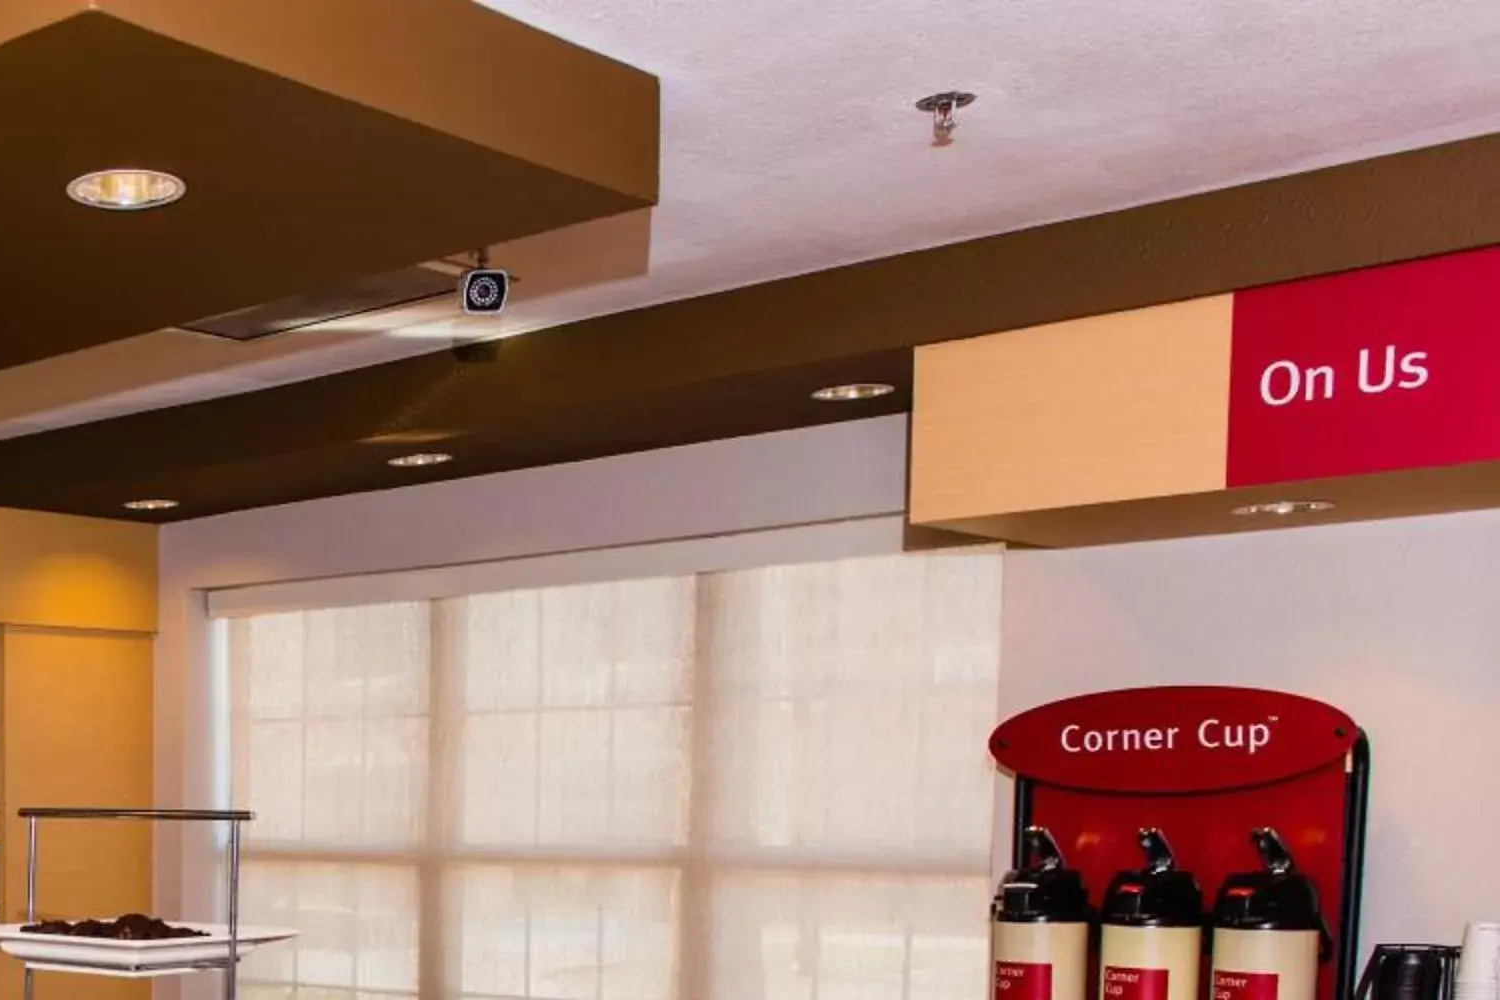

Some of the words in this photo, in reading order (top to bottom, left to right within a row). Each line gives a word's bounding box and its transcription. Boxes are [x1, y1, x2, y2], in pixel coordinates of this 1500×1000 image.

[1259, 359, 1334, 406] On
[1357, 343, 1430, 394] Us
[1060, 723, 1180, 753] Corner
